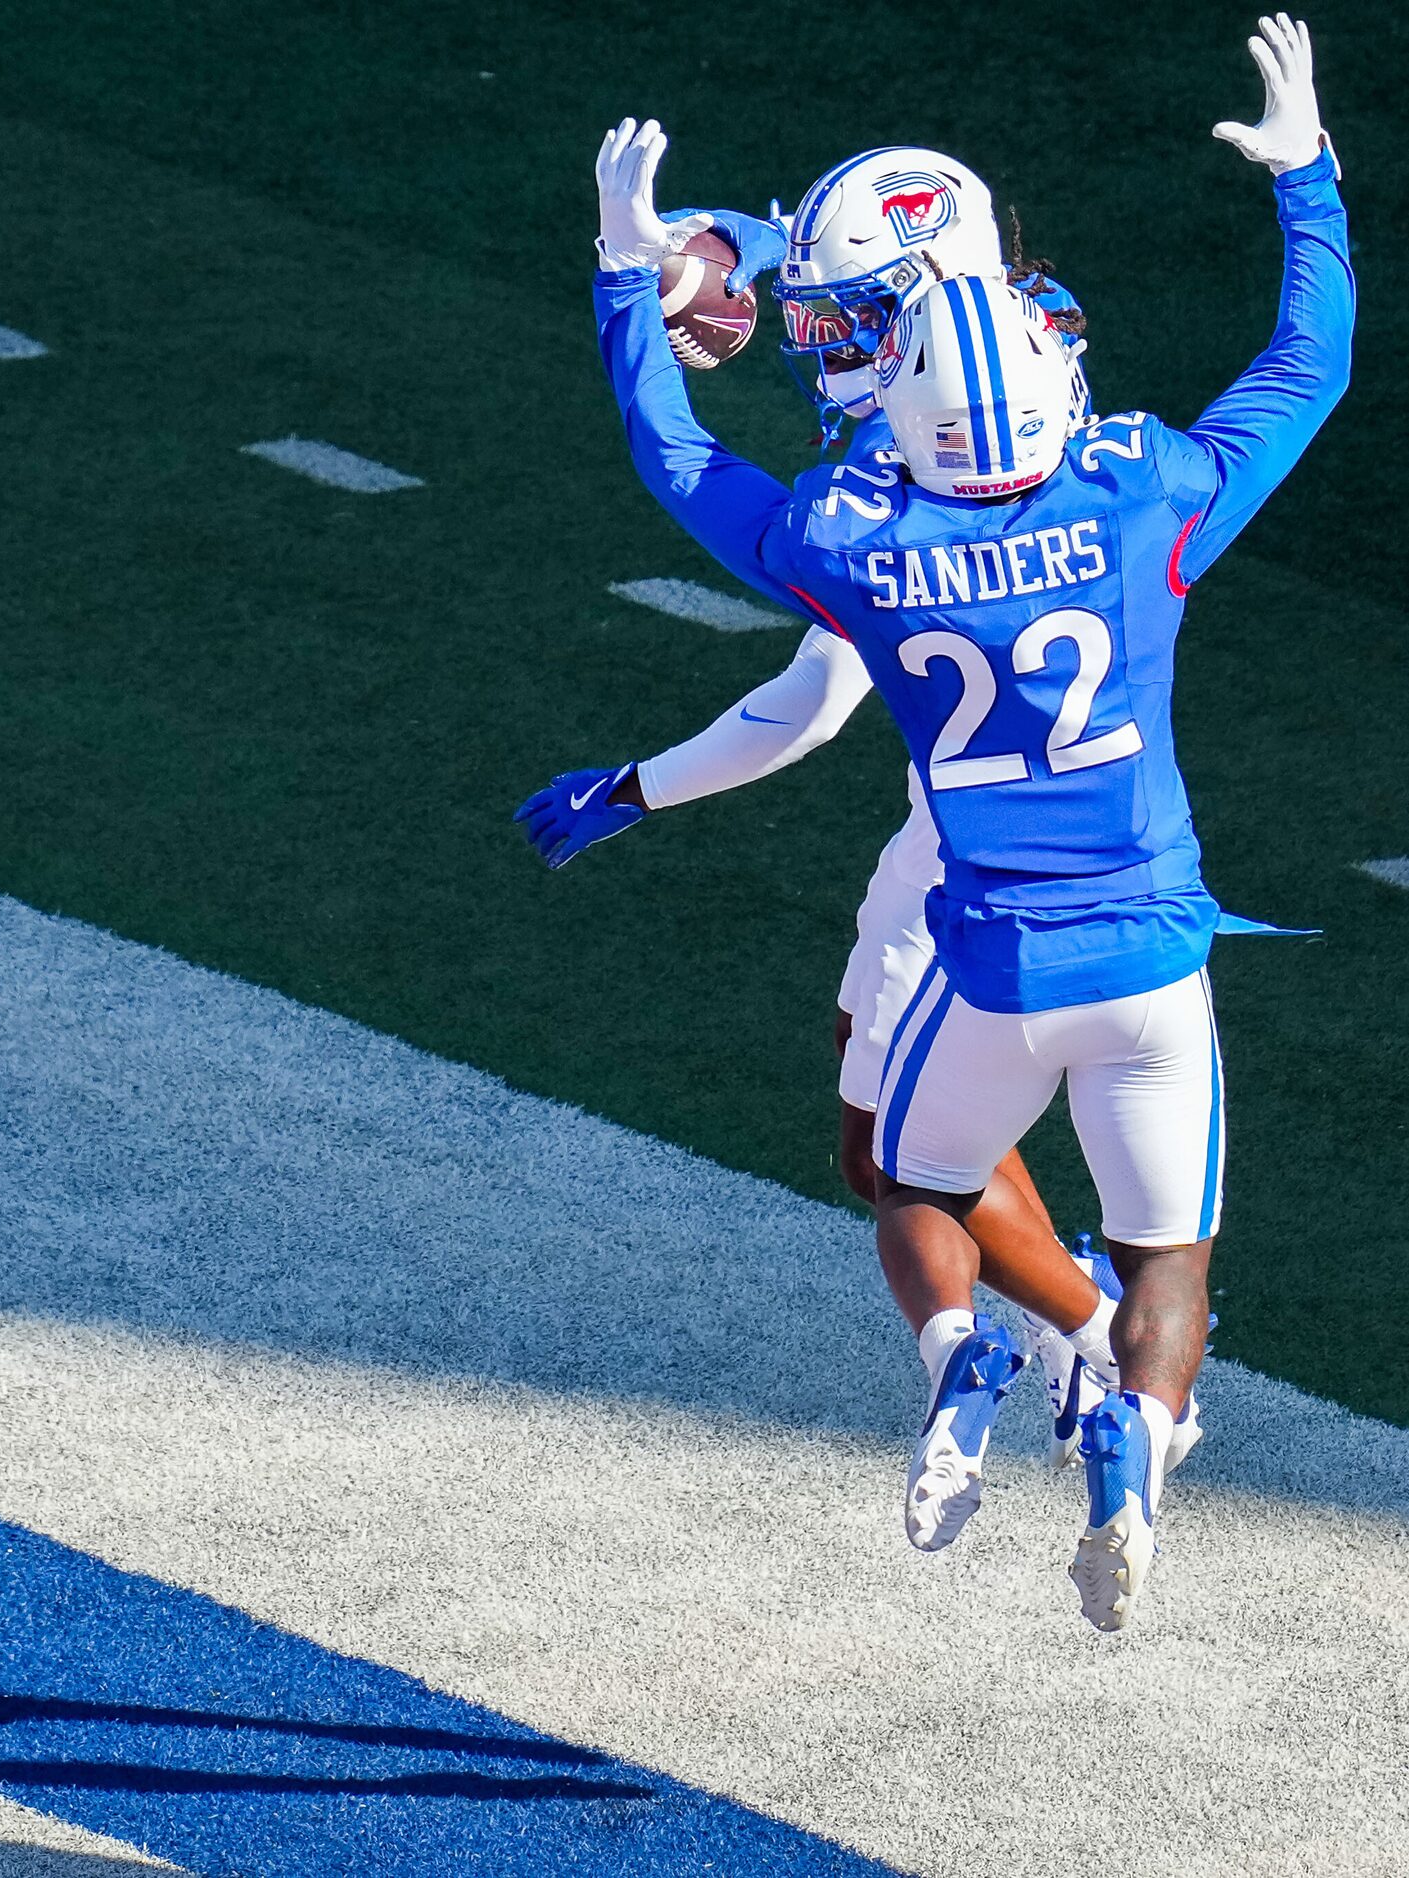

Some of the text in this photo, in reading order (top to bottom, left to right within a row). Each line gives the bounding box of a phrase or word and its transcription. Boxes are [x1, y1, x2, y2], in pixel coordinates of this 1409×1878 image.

[1020, 419, 1043, 435] ACC
[1081, 411, 1143, 472] 22
[825, 465, 899, 521] 22
[952, 471, 1043, 495] MUSTANGS
[867, 519, 1107, 609] SANDERS
[898, 606, 1145, 791] 22
